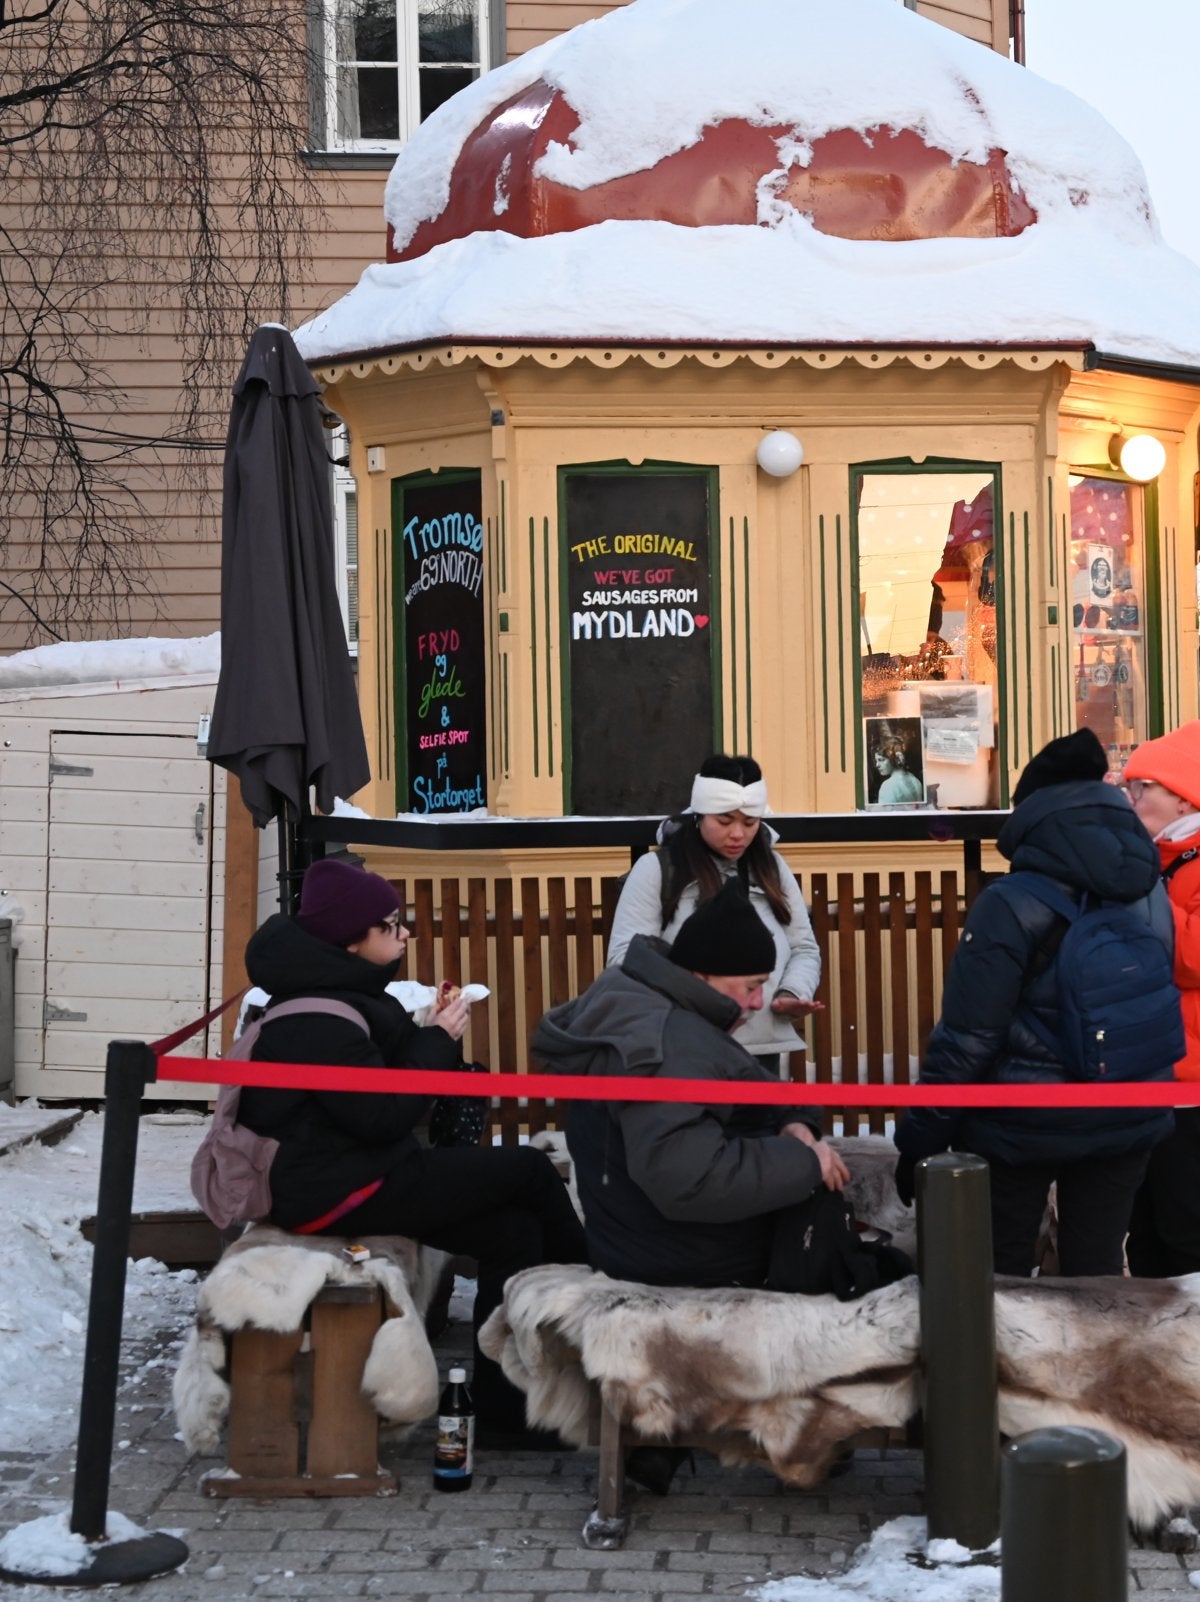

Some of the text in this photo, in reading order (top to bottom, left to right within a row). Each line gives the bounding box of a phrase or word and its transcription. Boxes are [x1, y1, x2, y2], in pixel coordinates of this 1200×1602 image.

[403, 512, 483, 560] Tromsø
[571, 534, 697, 562] THE ORIGINAL
[440, 550, 483, 598] NORTH
[594, 568, 675, 585] WE'VE GOT
[582, 588, 698, 606] SAUSAGES FROM
[572, 608, 695, 640] MYDLAND
[418, 629, 460, 660] FRYD
[435, 654, 447, 677] og
[418, 665, 466, 719] glede
[441, 706, 450, 727] &
[419, 730, 469, 750] SELFIE SPOT
[436, 752, 447, 779] på
[413, 774, 485, 814] Stortorget
